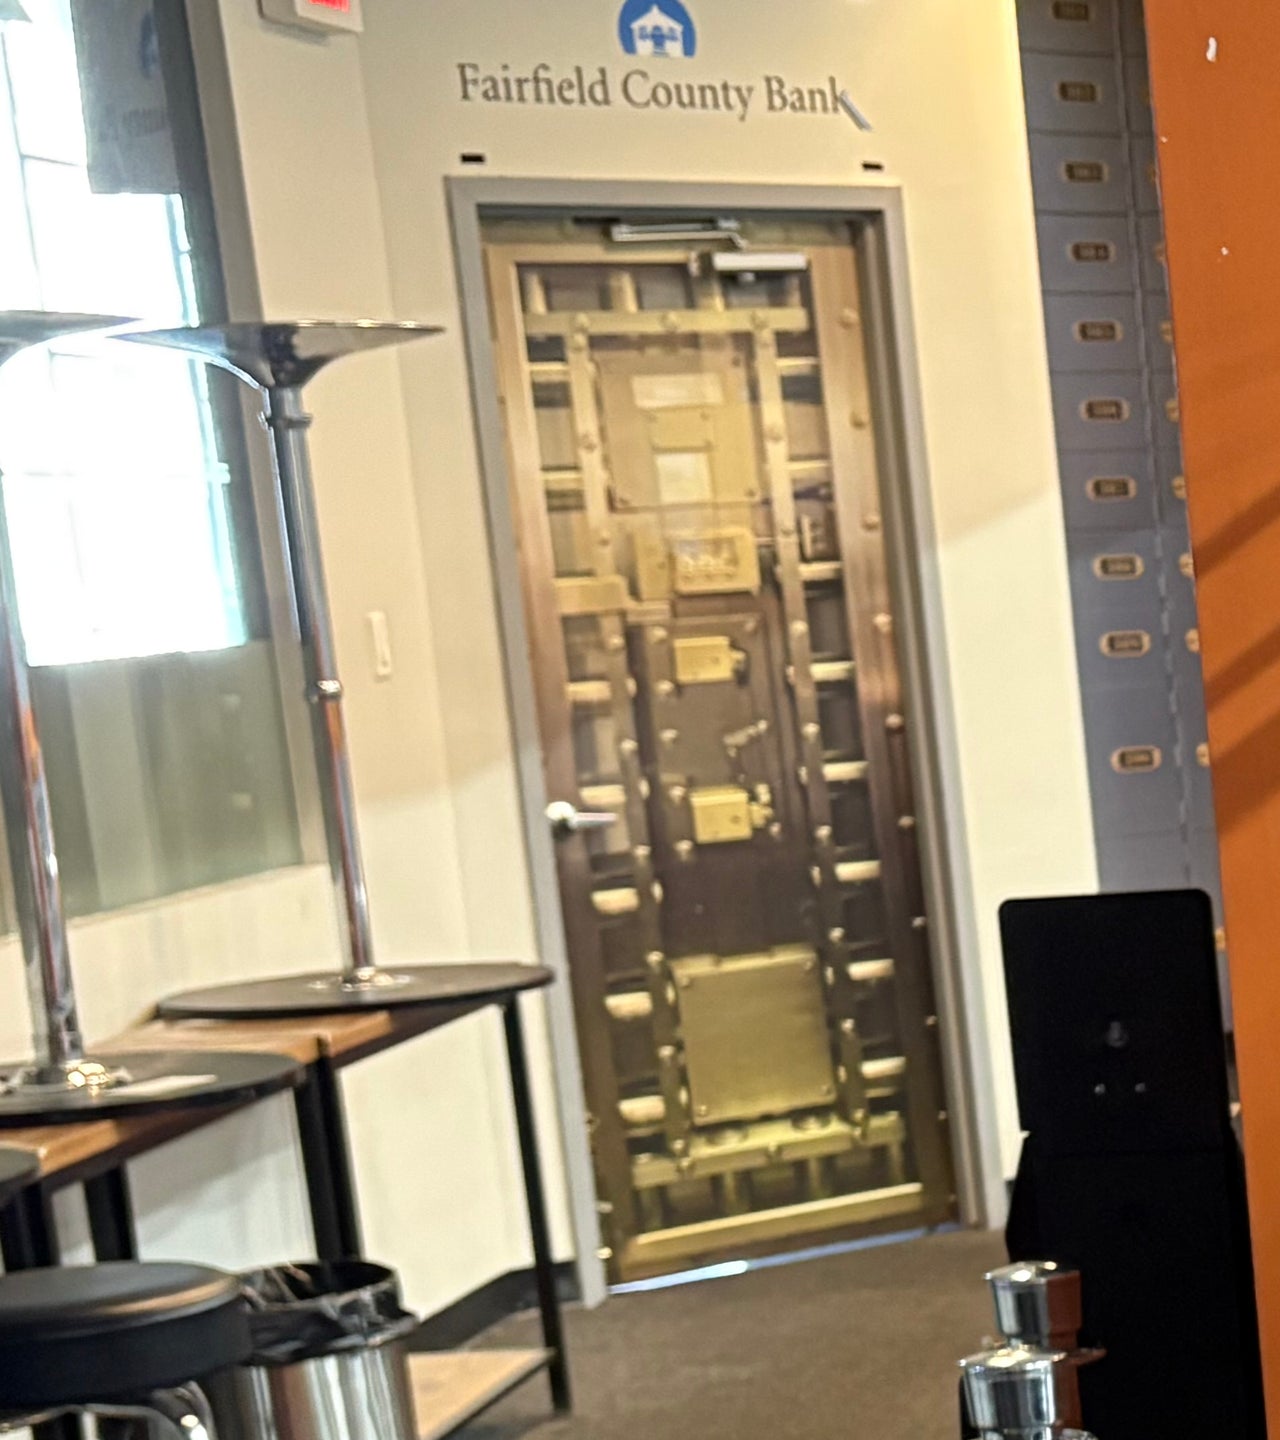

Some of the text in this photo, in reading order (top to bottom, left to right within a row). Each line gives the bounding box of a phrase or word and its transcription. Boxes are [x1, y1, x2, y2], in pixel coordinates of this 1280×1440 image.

[456, 62, 852, 122] Fairfield County Bank
